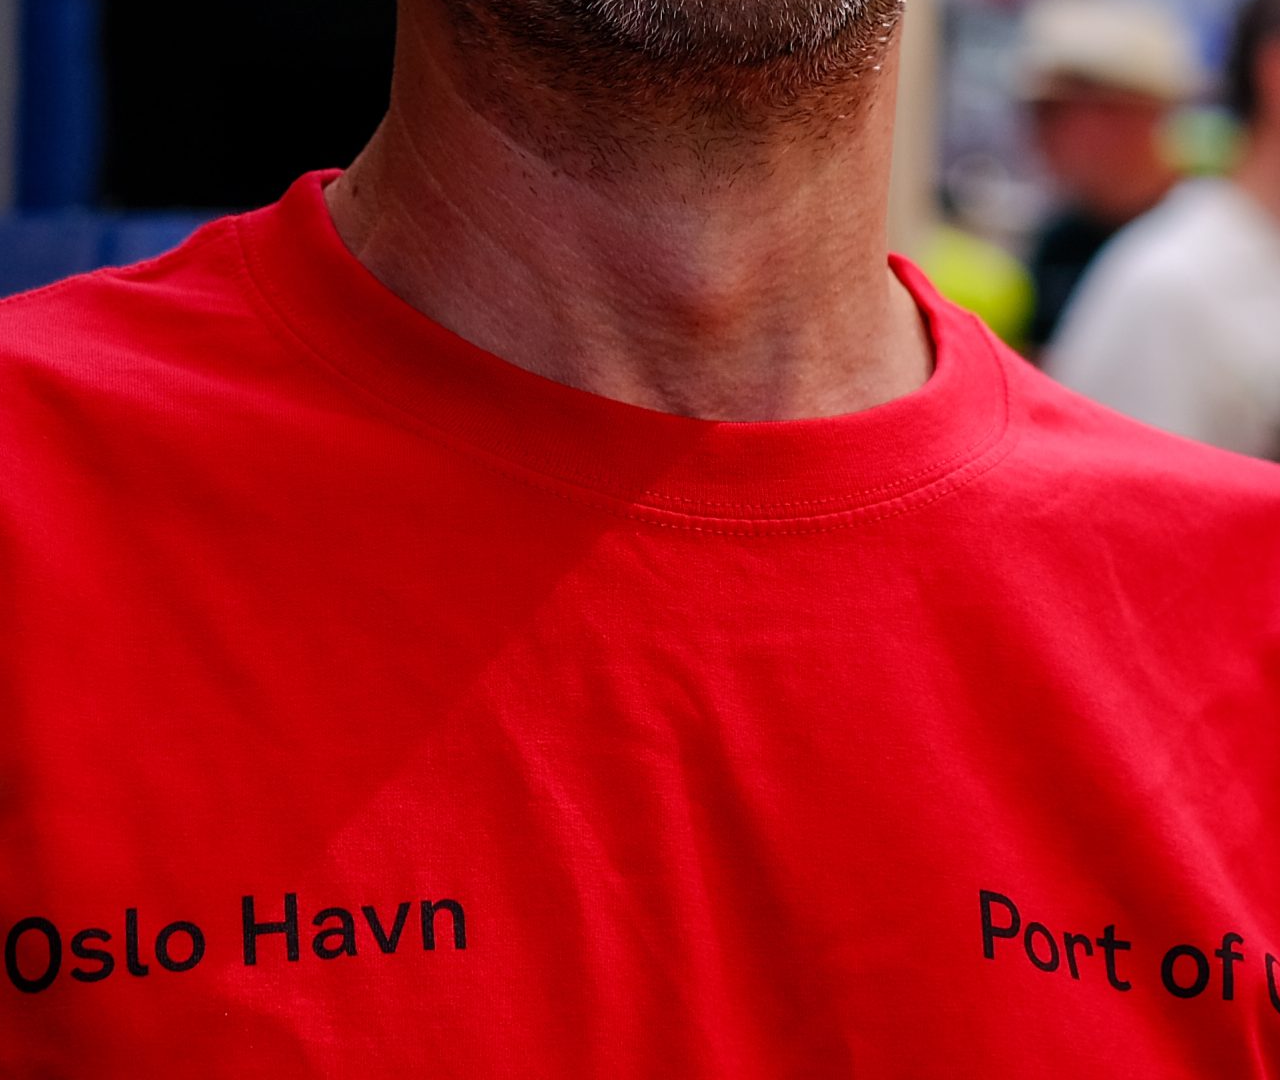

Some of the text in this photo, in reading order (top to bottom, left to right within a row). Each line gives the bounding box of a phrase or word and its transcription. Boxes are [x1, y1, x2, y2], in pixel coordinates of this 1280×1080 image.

[4, 892, 468, 994] Oslo Havn
[978, 889, 1132, 992] Port
[1160, 932, 1245, 1001] of
